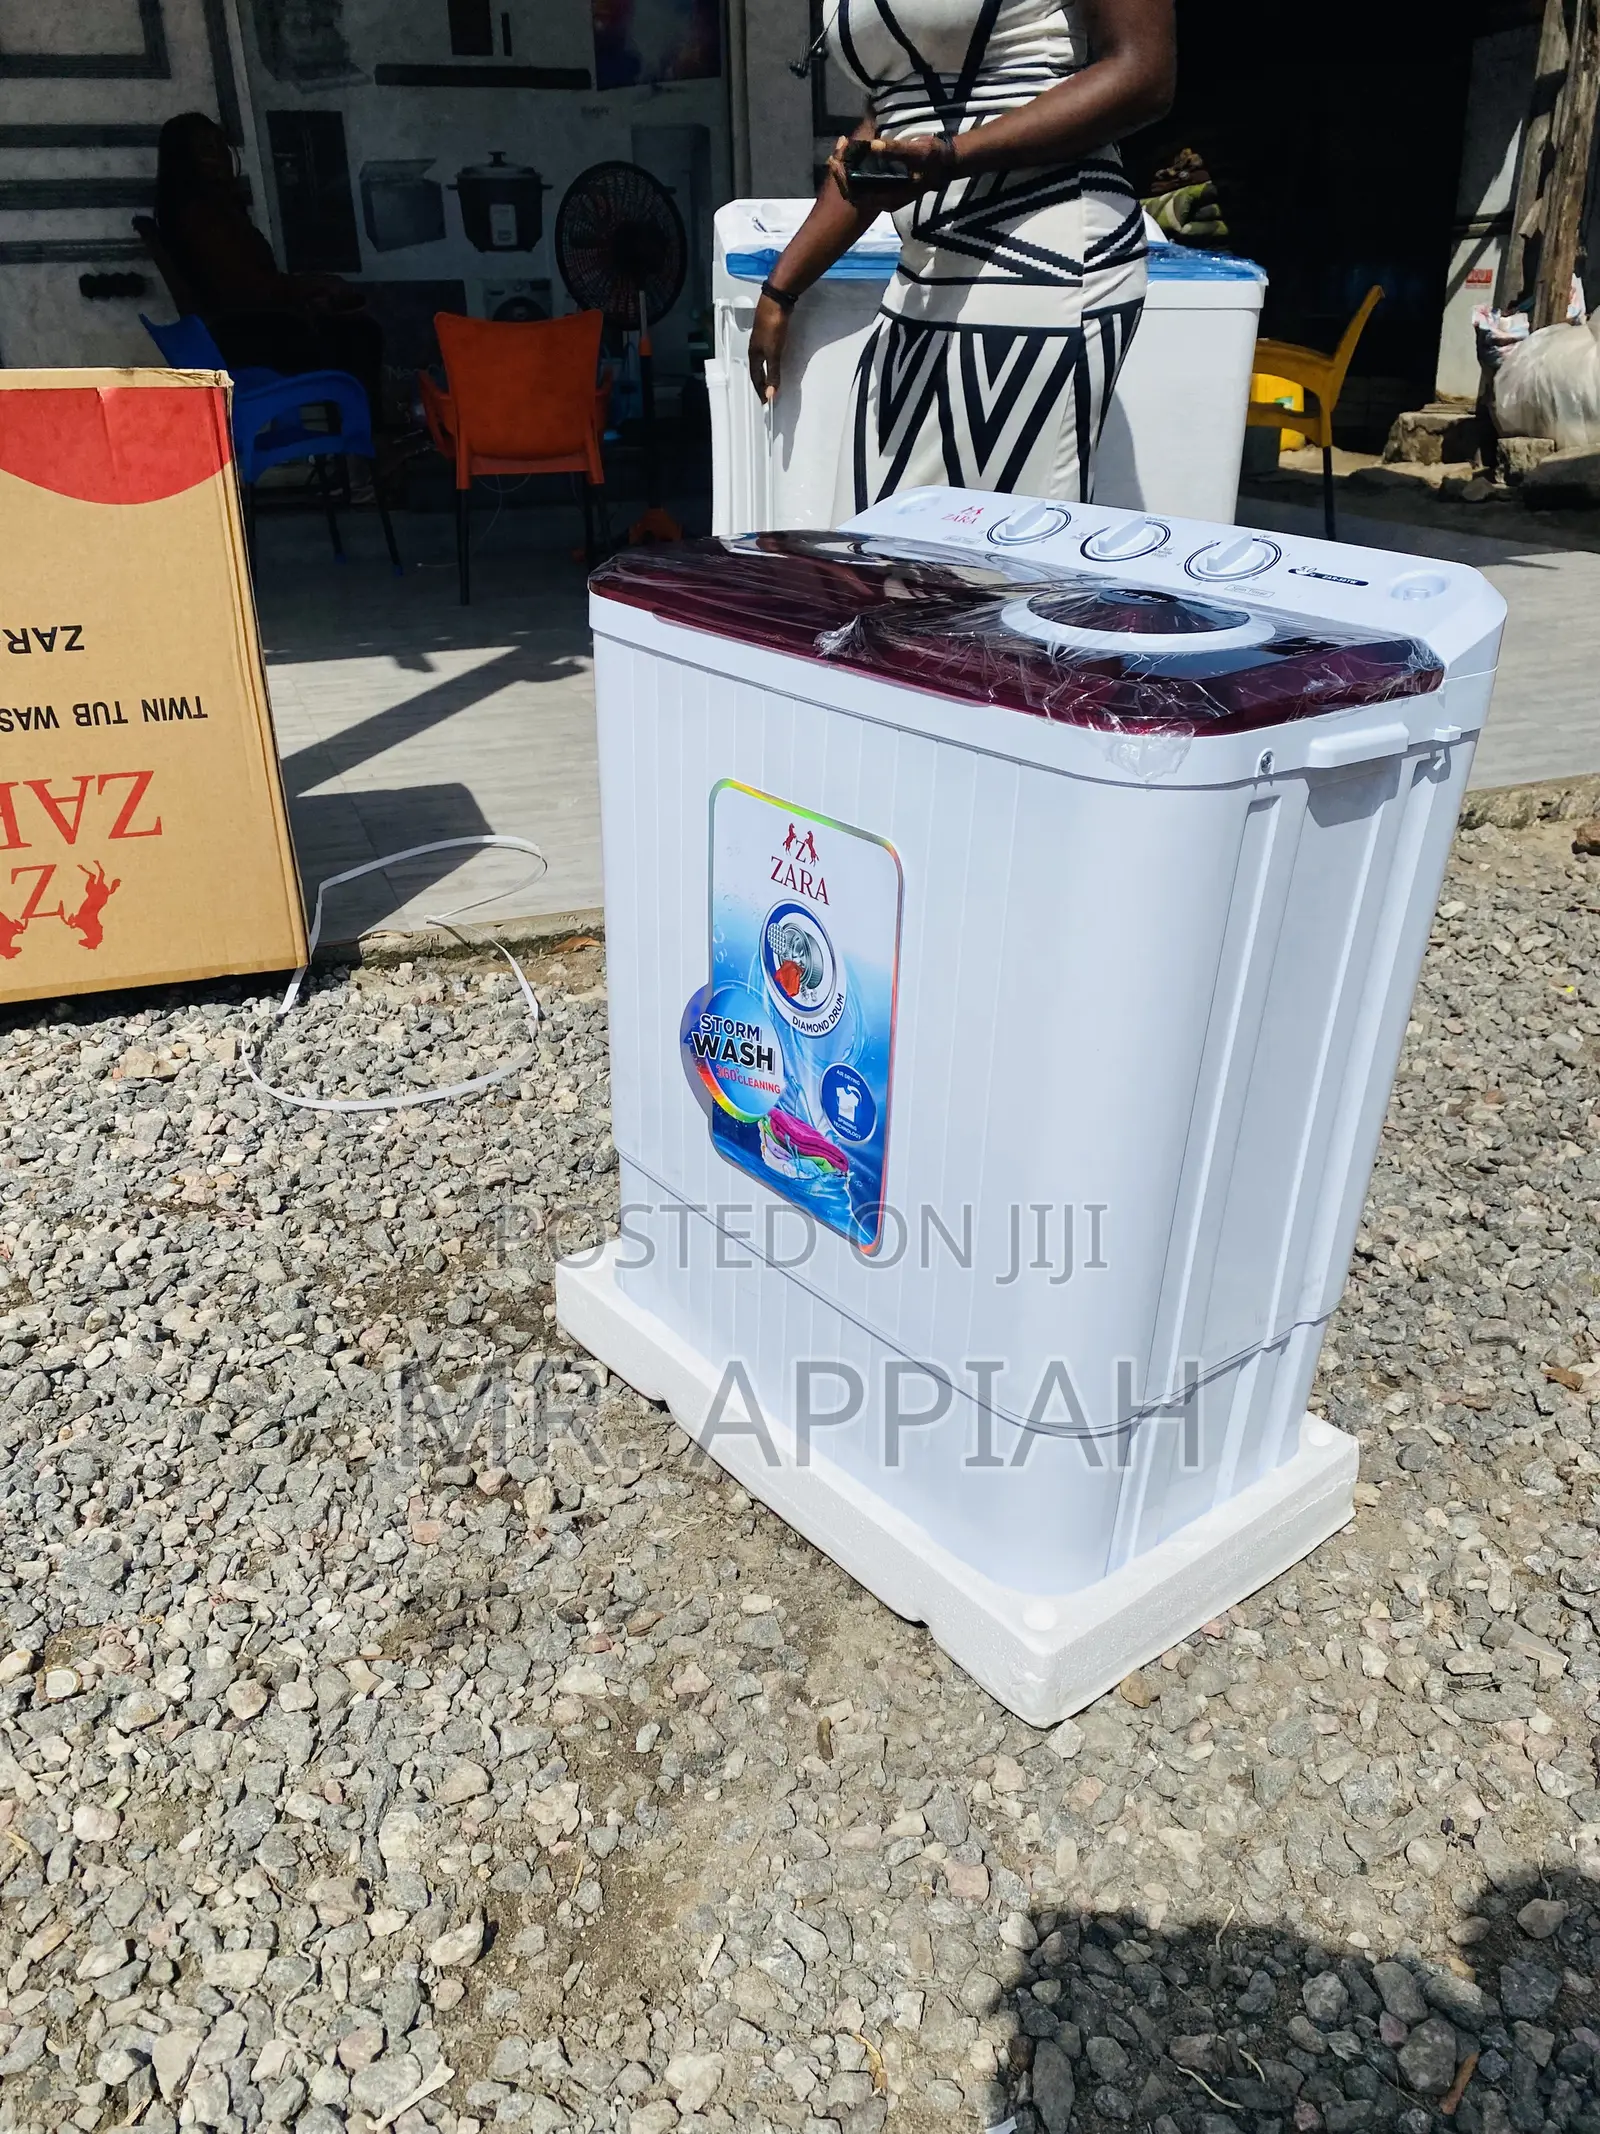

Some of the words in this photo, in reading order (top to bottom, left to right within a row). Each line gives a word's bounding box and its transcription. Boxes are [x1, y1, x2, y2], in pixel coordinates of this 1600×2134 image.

[0, 705, 60, 732] WAS
[72, 701, 128, 726] TUB
[141, 696, 208, 722] TWIN
[770, 855, 830, 906] ZARA
[792, 1015, 830, 1033] DIAMOND
[828, 992, 845, 1024] DRUM
[700, 1014, 760, 1042] STORM
[692, 1033, 774, 1072] WASH
[737, 1075, 781, 1095] CLEANING
